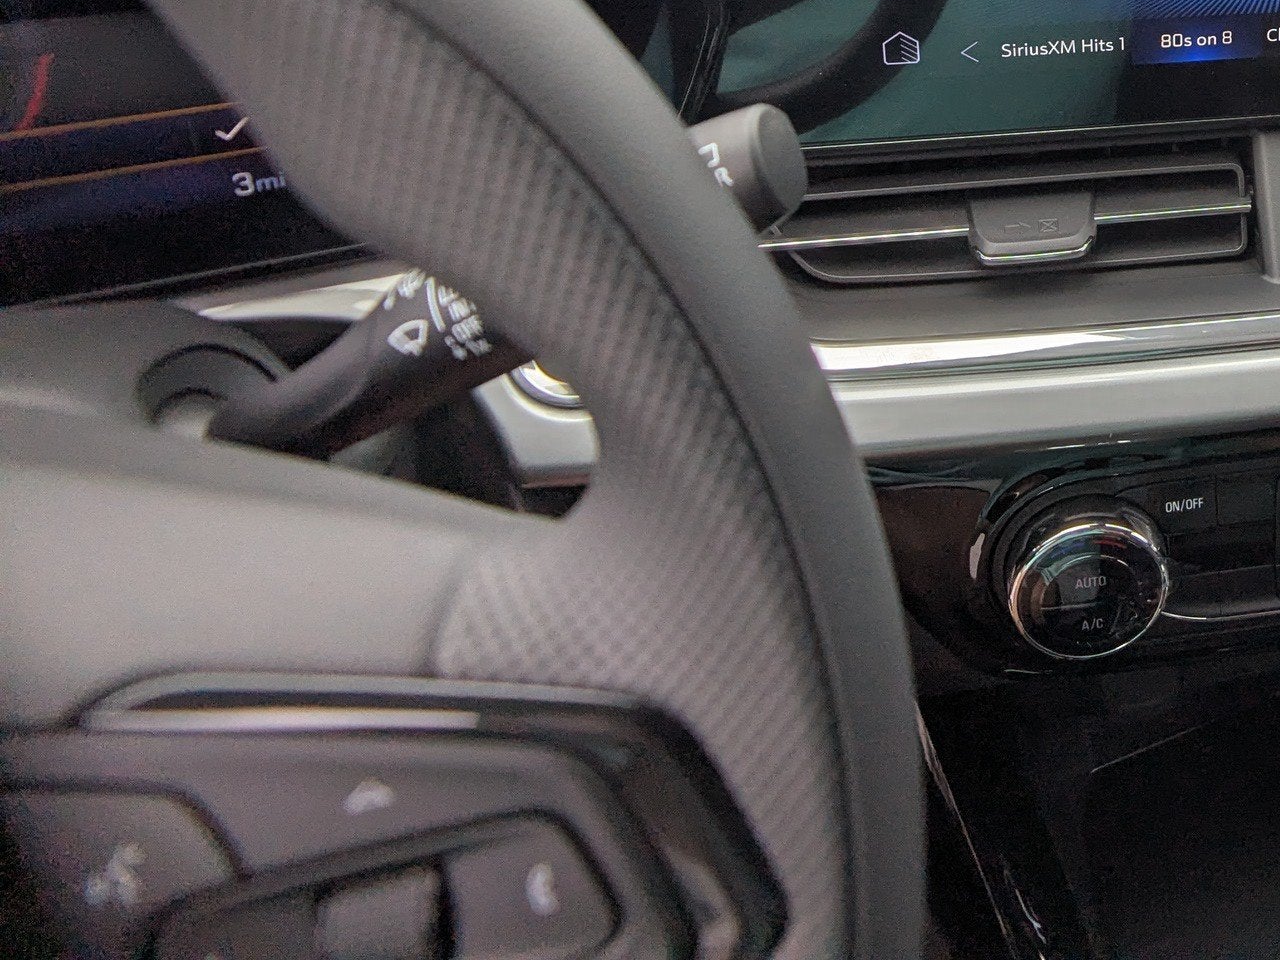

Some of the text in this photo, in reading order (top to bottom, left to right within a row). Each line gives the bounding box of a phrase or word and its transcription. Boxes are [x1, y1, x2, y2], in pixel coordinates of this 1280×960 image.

[1160, 30, 1233, 48] 80s on 8
[1001, 37, 1126, 59] SiriusXM Hits 1
[1165, 497, 1204, 513] ON/OFF
[1075, 575, 1106, 589] AUTO
[1081, 618, 1103, 631] A/C
